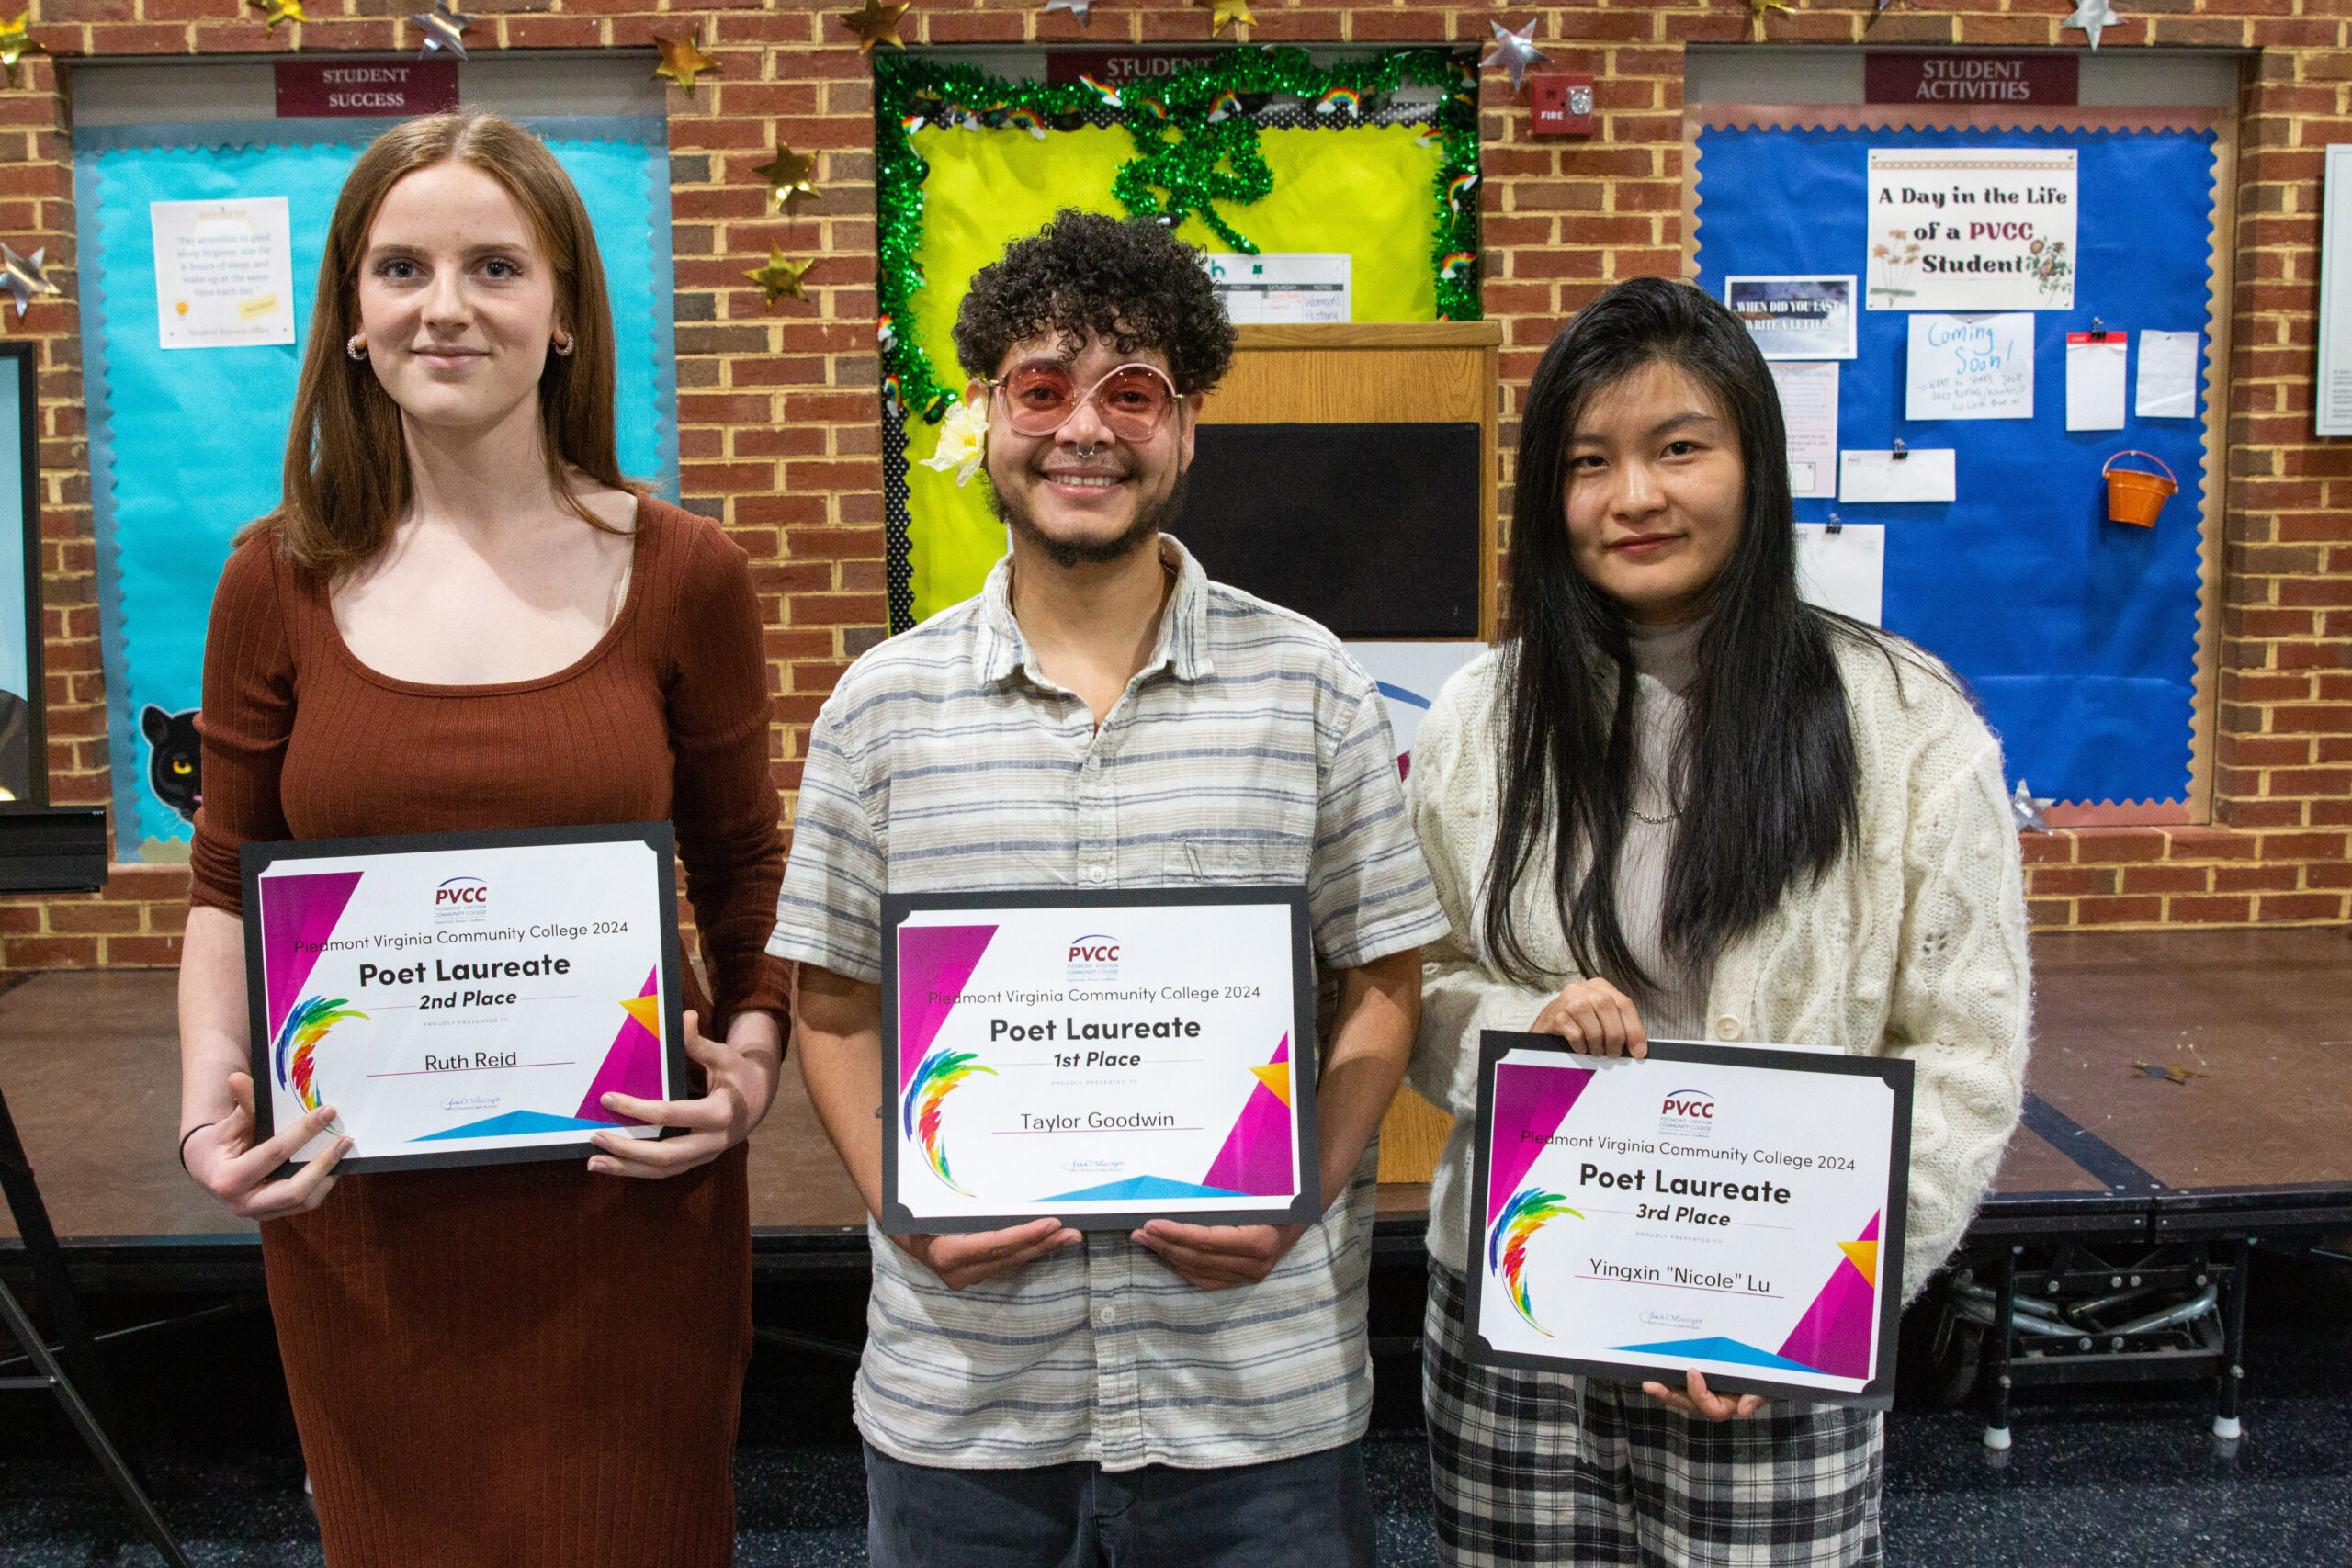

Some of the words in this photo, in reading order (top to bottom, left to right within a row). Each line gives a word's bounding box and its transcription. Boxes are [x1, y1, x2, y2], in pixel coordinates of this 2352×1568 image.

[323, 68, 410, 83] STUDENT
[1923, 60, 2024, 80] STUDENT
[329, 92, 405, 107] SUCCESS
[1916, 80, 2030, 100] ACTIVITIES
[1541, 110, 1564, 120] FIRE
[1879, 188, 1893, 204] A
[1902, 188, 1946, 209] Day
[1952, 186, 1975, 204] in
[1984, 188, 2019, 204] the
[2027, 187, 2067, 204] Life
[198, 234, 237, 244] attention
[251, 233, 271, 244] good
[1914, 222, 1940, 240] of
[1946, 227, 1961, 240] a
[1970, 222, 2033, 241] PVCC
[189, 262, 215, 271] hours
[1922, 255, 2023, 273] Student
[1736, 300, 1768, 312] WHEN
[1770, 300, 1788, 312] DID
[1789, 300, 1810, 312] YOU
[1814, 300, 1838, 312] LAST
[1745, 319, 1777, 331] WRITE
[1928, 321, 1994, 356] Coming
[435, 886, 487, 905] PVCC
[294, 937, 369, 953] Piedmont
[374, 932, 432, 950] Virginia
[436, 927, 526, 943] Community
[529, 924, 588, 940] College
[593, 921, 628, 935] 2024
[1069, 945, 1120, 962] PVCC
[359, 962, 426, 987] Poet
[436, 954, 571, 982] Laureate
[419, 991, 457, 1010] 2nd
[462, 990, 517, 1007] Place
[928, 991, 1002, 1005] Piedmont
[1006, 989, 1063, 1007] Virginia
[1069, 987, 1157, 1003] Community
[1161, 986, 1219, 1002] College
[1224, 985, 1261, 998] 2024
[990, 1019, 1057, 1042] Poet
[1067, 1017, 1201, 1040] Laureate
[425, 1055, 469, 1071] Ruth
[475, 1052, 517, 1068] Reid
[1054, 1052, 1080, 1067] 1st
[1086, 1051, 1141, 1067] Place
[1662, 1100, 1714, 1119] PVCC
[1020, 1112, 1081, 1132] Taylor
[1088, 1111, 1175, 1129] Goodwin
[1521, 1130, 1593, 1148] Piedmont
[1598, 1135, 1655, 1155] Virginia
[1659, 1142, 1748, 1165] Community
[1753, 1150, 1813, 1170] College
[1817, 1156, 1855, 1171] 2024
[1580, 1163, 1645, 1190] Poet
[1655, 1169, 1791, 1204] Laureate
[1636, 1203, 1670, 1221] 3rd
[1675, 1206, 1731, 1226] Place
[1635, 1231, 1668, 1239] PROUDLY
[1670, 1235, 1711, 1243] PRESENTED
[1590, 1258, 1659, 1281] Yingxin
[1667, 1266, 1741, 1288] "Nicole"
[1748, 1275, 1770, 1292] Lu
